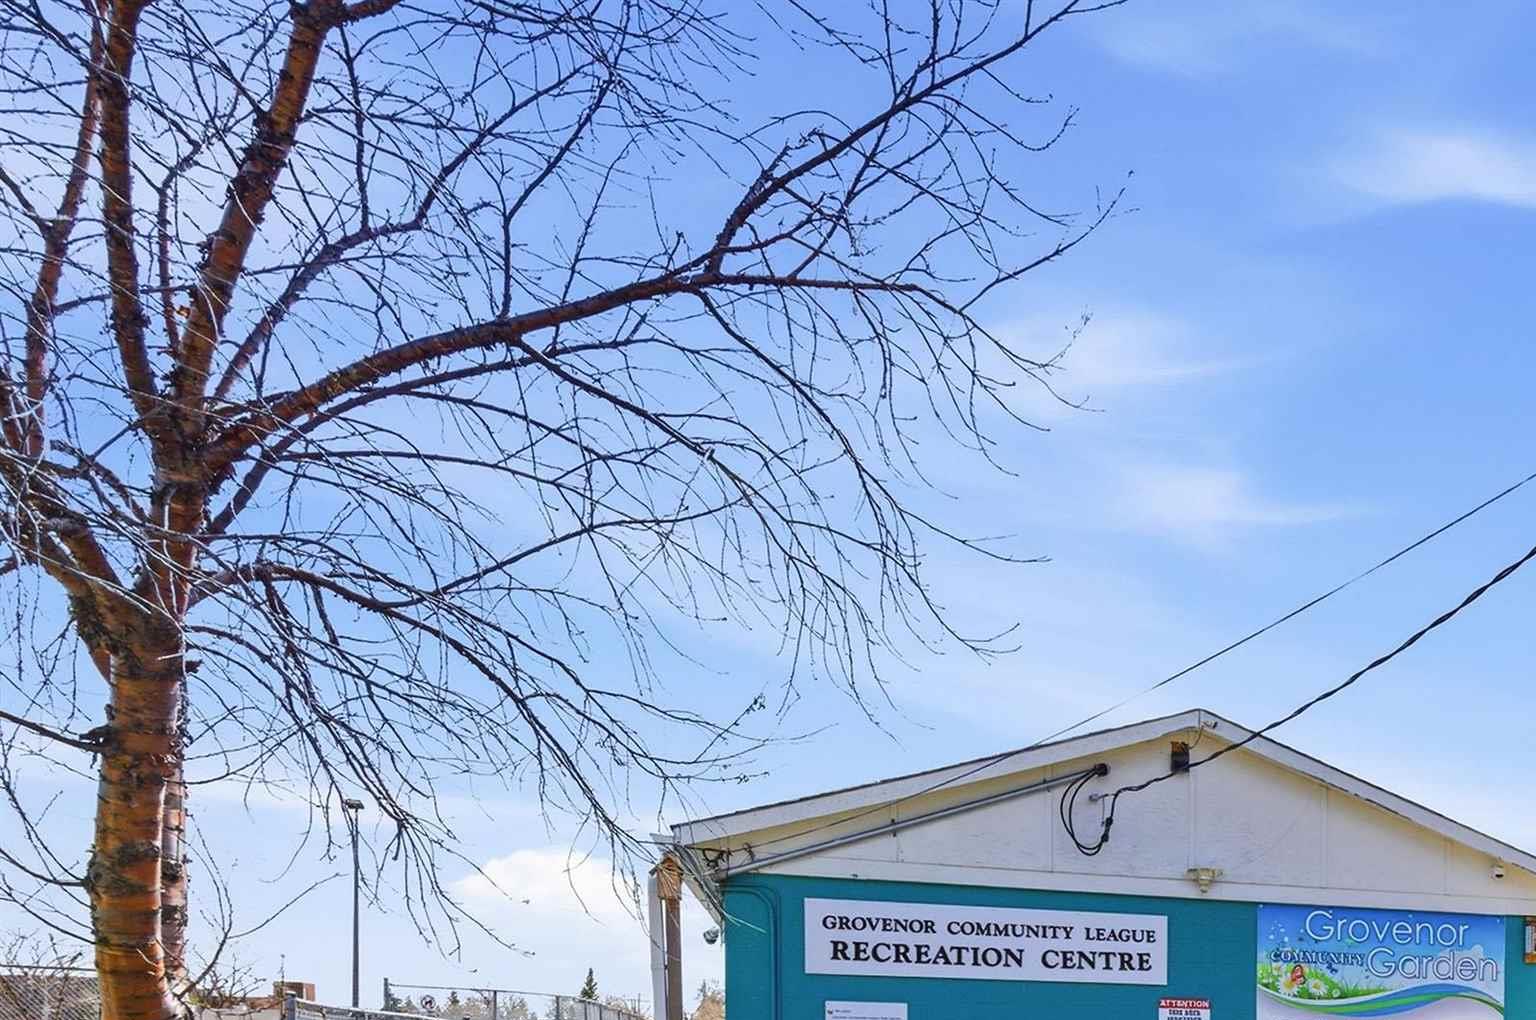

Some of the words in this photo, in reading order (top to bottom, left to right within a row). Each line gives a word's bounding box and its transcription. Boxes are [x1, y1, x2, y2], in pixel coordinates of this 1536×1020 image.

[822, 915, 936, 934] GROVENOR
[947, 921, 1074, 940] COMMUNITY
[1085, 927, 1157, 943] LEAGUE
[1305, 910, 1470, 946] Grovenor
[830, 940, 1025, 968] RECREATION
[1041, 949, 1153, 971] CENTRE
[1270, 949, 1365, 967] COMMUNITY
[1367, 947, 1498, 982] Garden
[1160, 1000, 1209, 1008] ATTENTION
